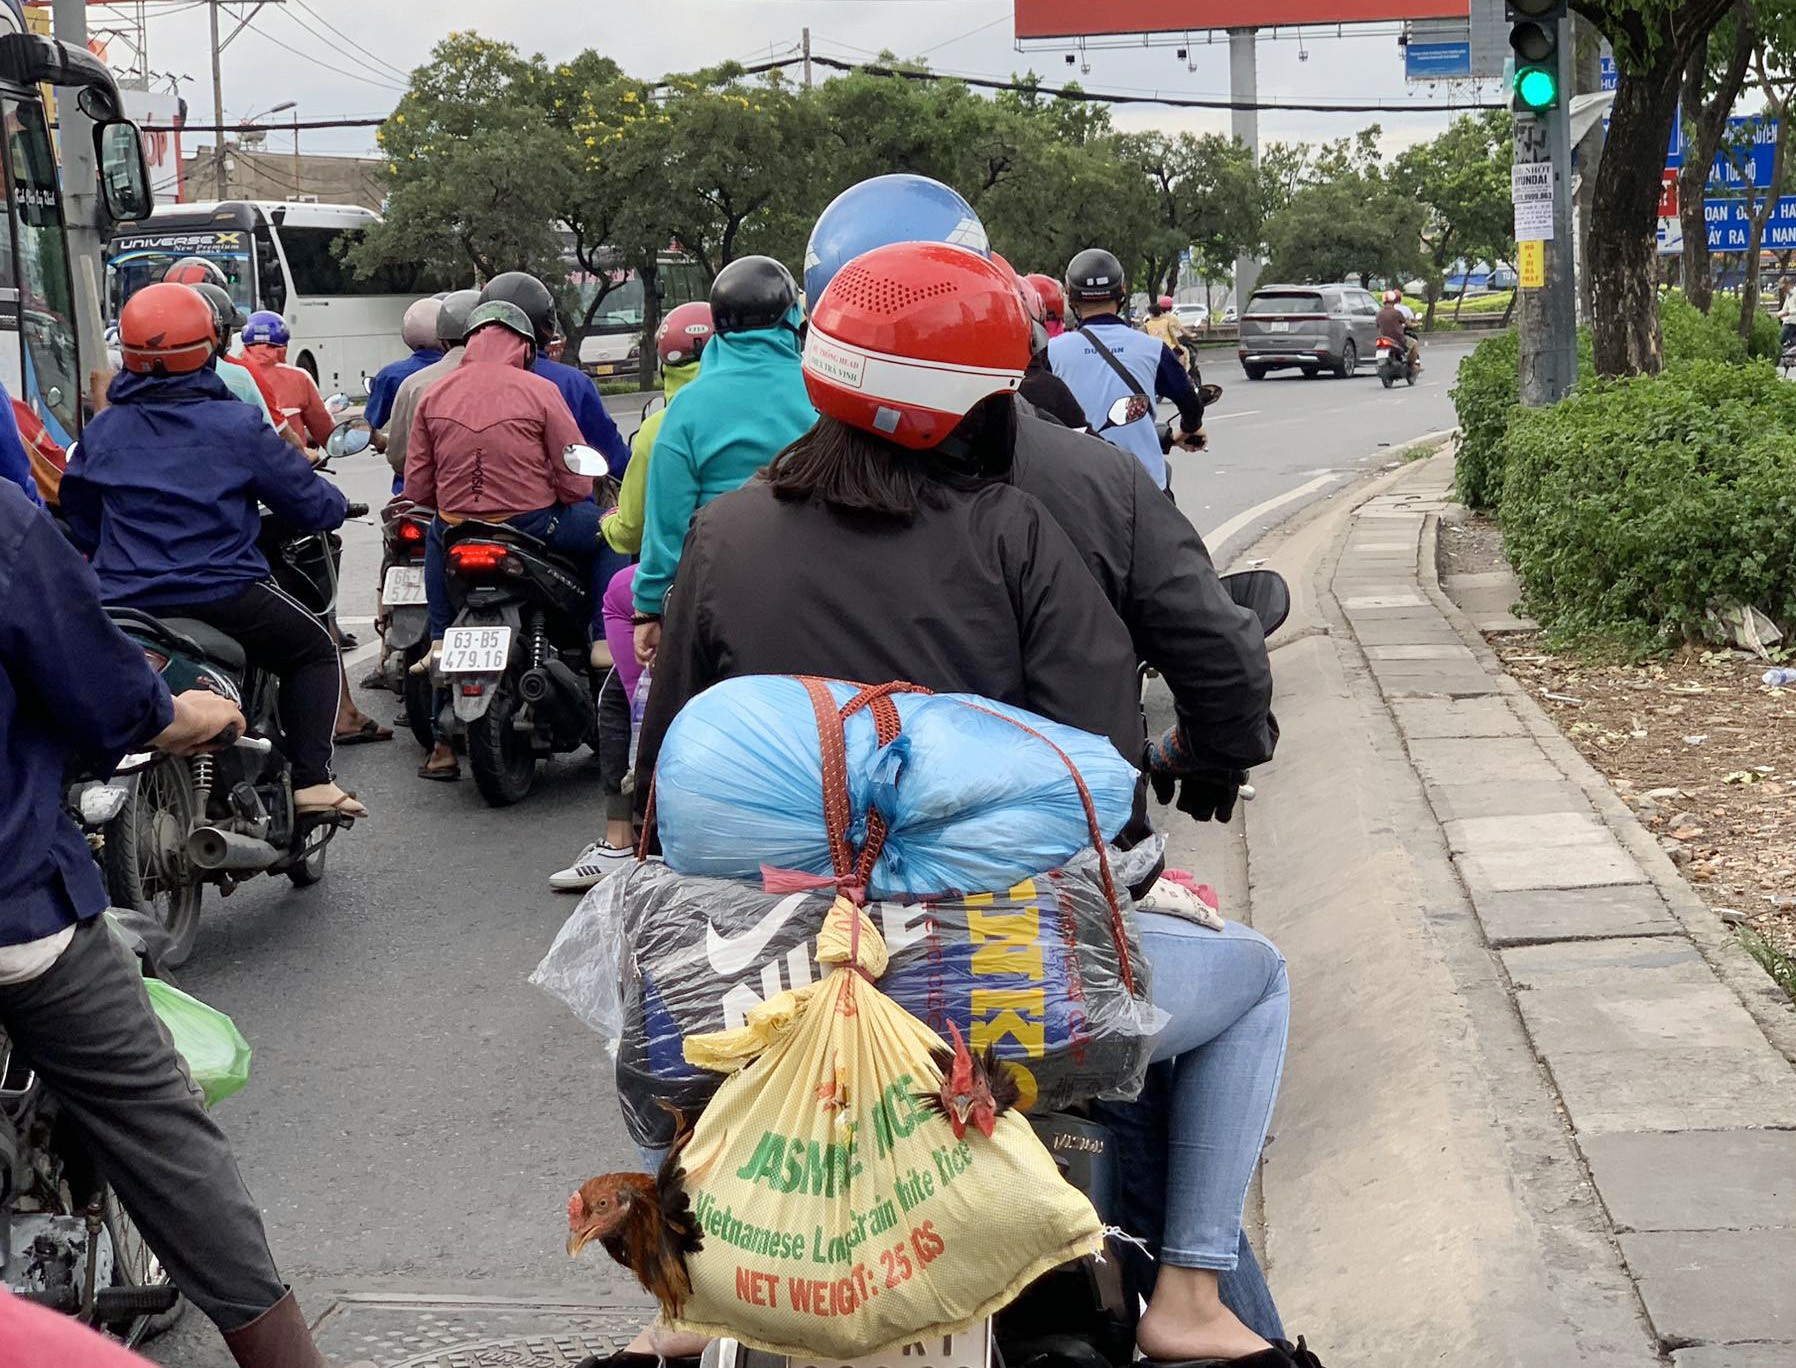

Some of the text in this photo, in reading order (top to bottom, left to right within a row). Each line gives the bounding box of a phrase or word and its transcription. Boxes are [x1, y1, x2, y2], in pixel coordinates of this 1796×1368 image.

[1704, 205, 1728, 224] OẠN
[120, 232, 240, 250] UNIVERSE X
[1729, 228, 1746, 245] RA
[454, 631, 499, 649] 63-B5
[445, 650, 503, 669] 479.16
[696, 1190, 805, 1260] Vietnamese
[735, 1266, 780, 1308] NET
[880, 1242, 913, 1290] 25
